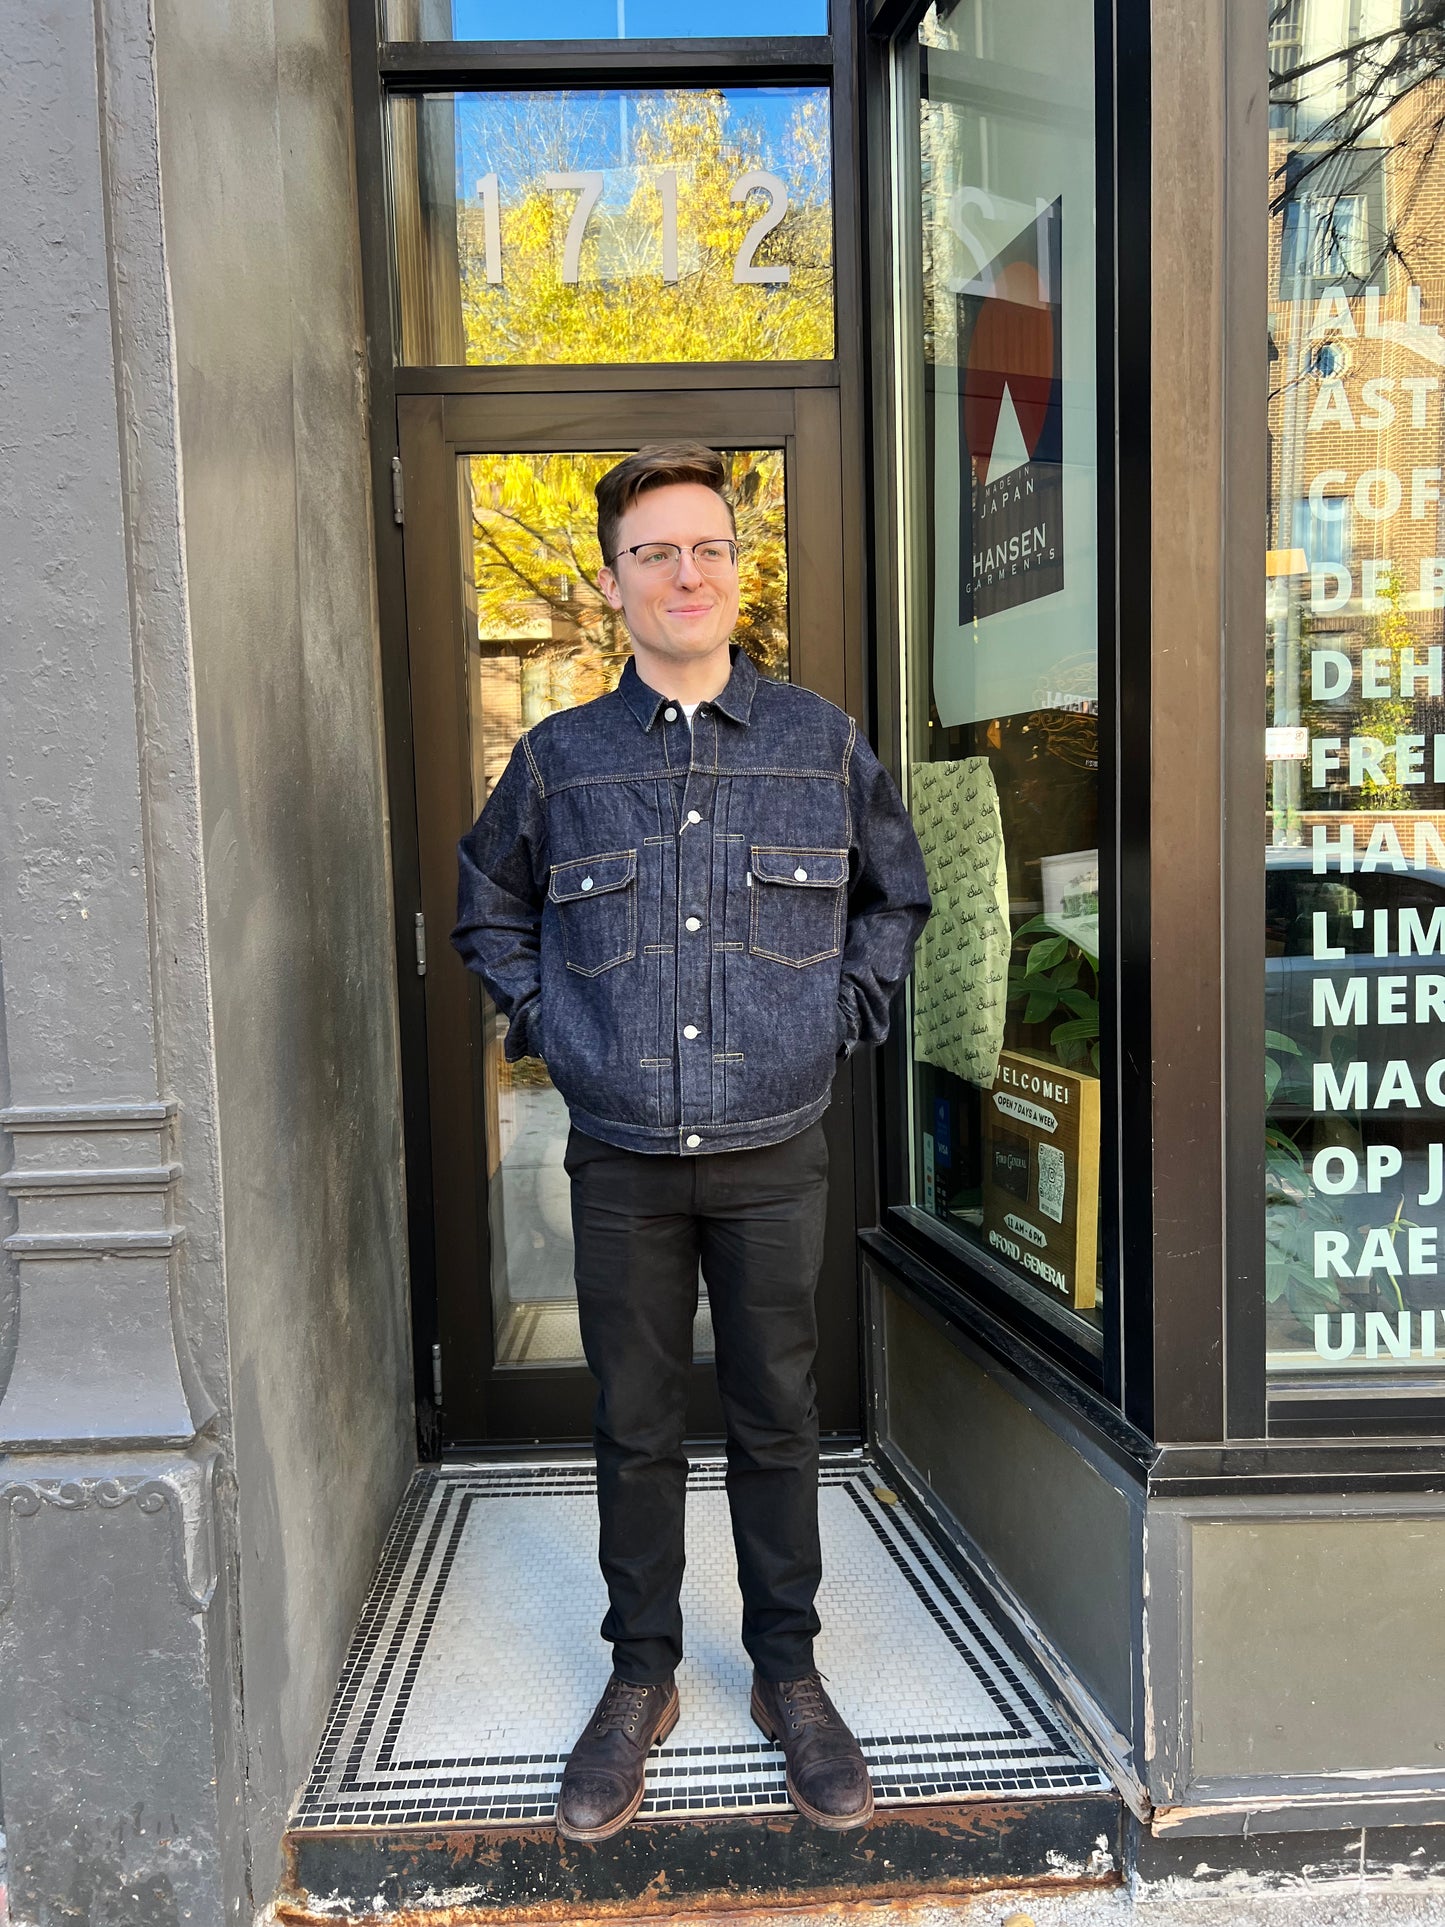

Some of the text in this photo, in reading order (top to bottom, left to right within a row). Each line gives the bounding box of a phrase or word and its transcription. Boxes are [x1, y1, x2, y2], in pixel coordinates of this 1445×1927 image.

[476, 170, 790, 284] 1712
[1306, 285, 1438, 339] ALL
[980, 478, 1034, 519] JAPAN
[985, 466, 1030, 498] MADE IN
[1308, 468, 1442, 522] COF
[966, 548, 1055, 593] GARMENTS
[973, 523, 1046, 577] HANSEN
[1310, 560, 1393, 612] DE
[1311, 646, 1442, 701] DEH
[1312, 821, 1445, 875] HAN
[1312, 906, 1445, 960] L'IM
[1312, 974, 1445, 1027] MER
[997, 1095, 1012, 1109] OPEN
[1018, 1104, 1033, 1118] DAYS
[1033, 1111, 1038, 1121] A
[1038, 1113, 1055, 1129] WEEK
[1312, 1143, 1443, 1206] OP J
[1007, 1216, 1013, 1229] 11
[1014, 1221, 1025, 1234] AM
[1028, 1230, 1033, 1238] 6
[1033, 1232, 1042, 1245] PM
[1313, 1226, 1438, 1278] RAE
[1313, 1310, 1445, 1361] UNI
